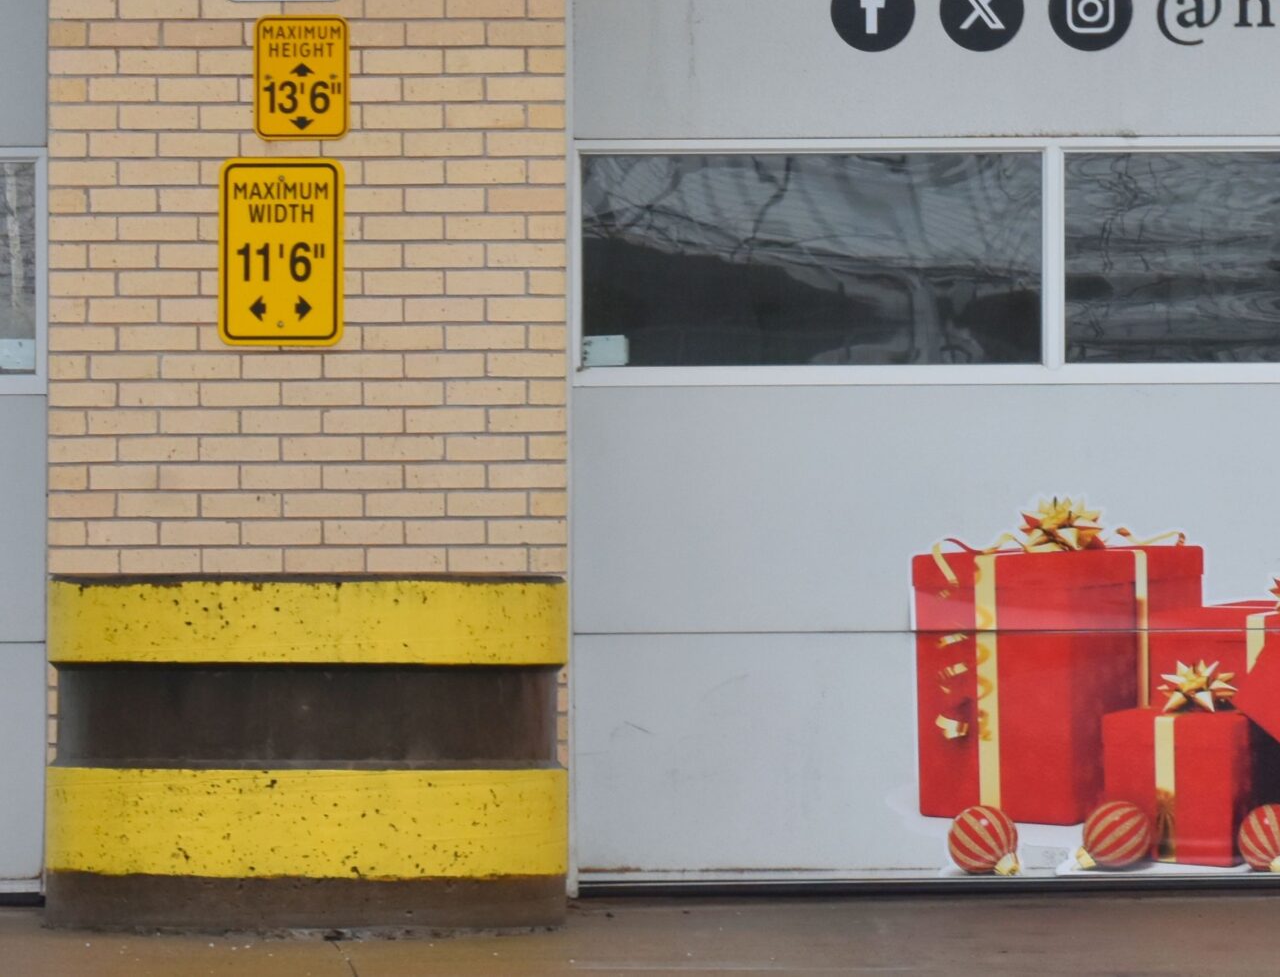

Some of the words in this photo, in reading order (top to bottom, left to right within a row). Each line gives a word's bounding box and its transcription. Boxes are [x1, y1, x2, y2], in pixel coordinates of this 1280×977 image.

[262, 26, 342, 41] MAXIMUM
[268, 42, 335, 59] HEIGHT
[233, 182, 329, 200] MAXIMUM
[248, 204, 315, 223] WIDTH
